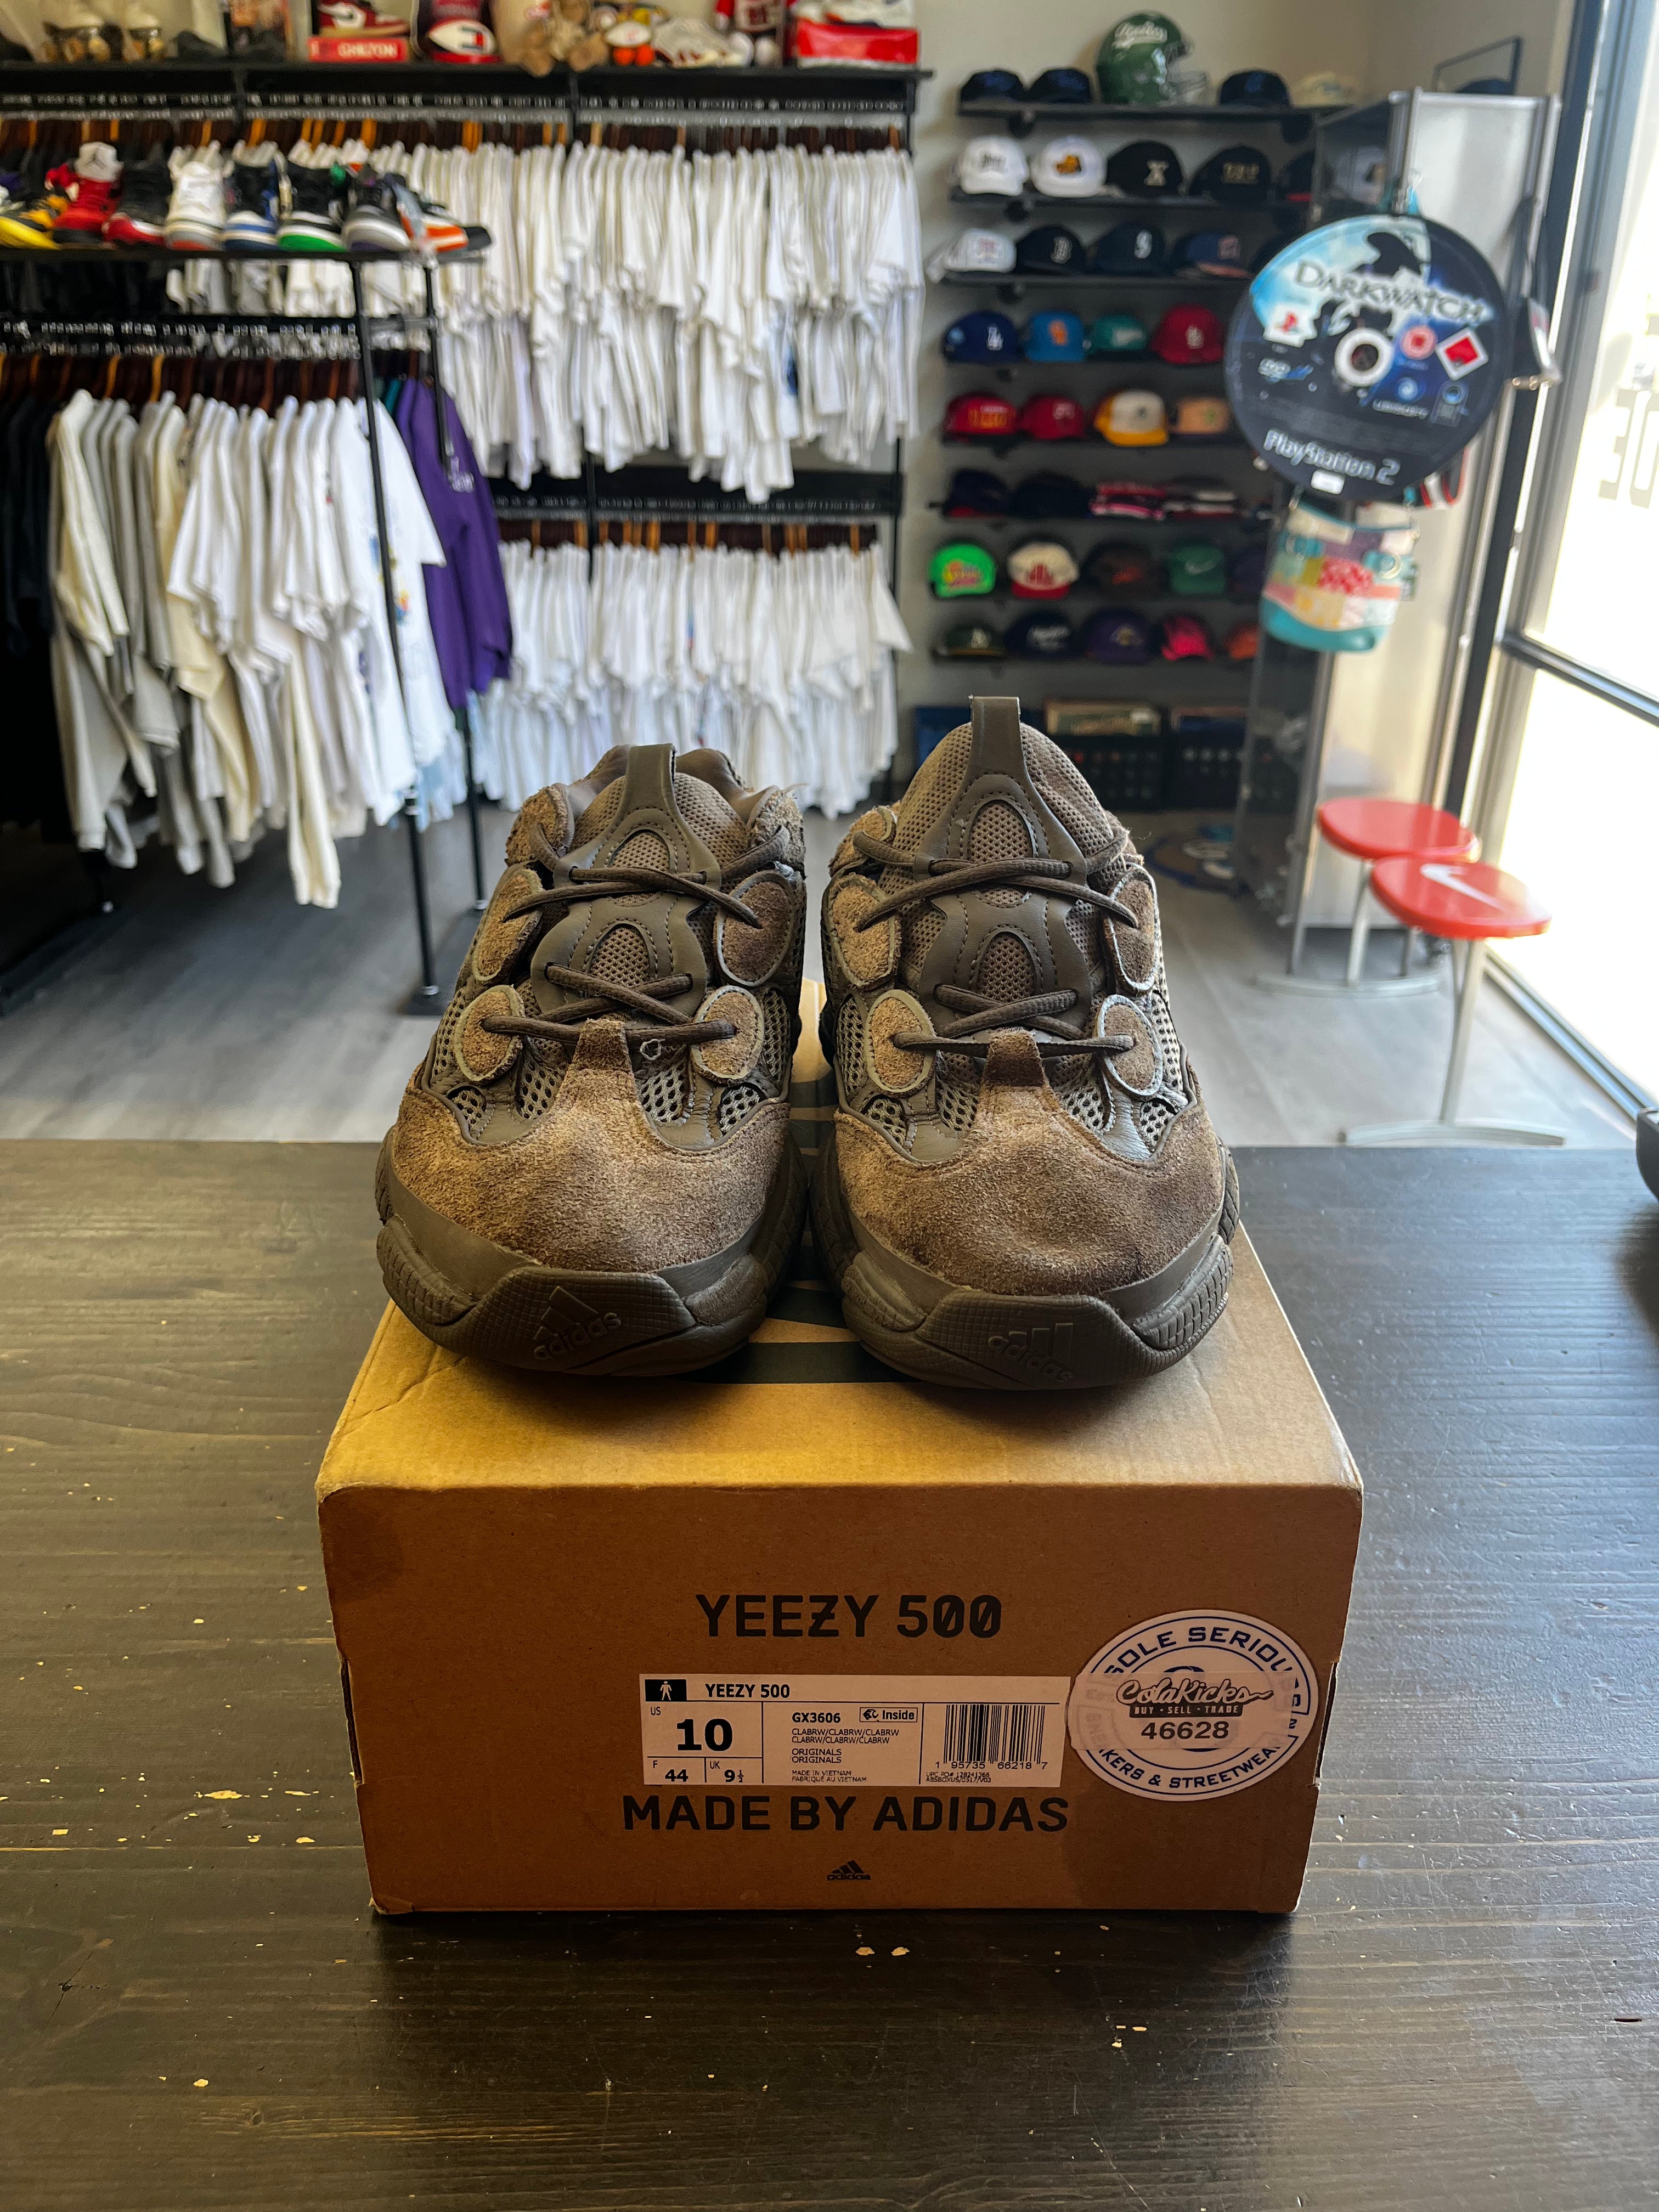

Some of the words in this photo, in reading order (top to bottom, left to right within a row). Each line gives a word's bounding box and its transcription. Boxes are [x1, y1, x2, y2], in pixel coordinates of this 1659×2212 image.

[1295, 262, 1488, 323] DARKWATCH
[1263, 429, 1376, 481] PlayStation
[1375, 459, 1400, 485] 2
[534, 1312, 621, 1360] adidas
[988, 1335, 1073, 1382] adidas
[696, 1594, 879, 1638] YEEZY
[896, 1594, 1002, 1639] 500
[705, 1684, 755, 1698] YEEZY
[760, 1684, 790, 1699] 500
[650, 1706, 661, 1716] US
[882, 1709, 915, 1720] Inside
[1205, 1705, 1238, 1713] TRADE
[792, 1712, 841, 1723] GX3606
[676, 1718, 733, 1751] 10
[792, 1729, 899, 1737] CLABRW/CLABRW/CLABRW
[1141, 1721, 1229, 1740] 46628
[792, 1736, 890, 1745] CLABRW/CLABRW/CLABRW
[653, 1760, 658, 1768] F
[710, 1760, 720, 1769] UK
[1148, 1774, 1161, 1786] &
[1169, 1747, 1280, 1788] STREETWEA
[665, 1769, 689, 1782] 44
[623, 1795, 771, 1831] MADE
[791, 1796, 857, 1831] BY
[873, 1796, 1069, 1832] ADIDAS
